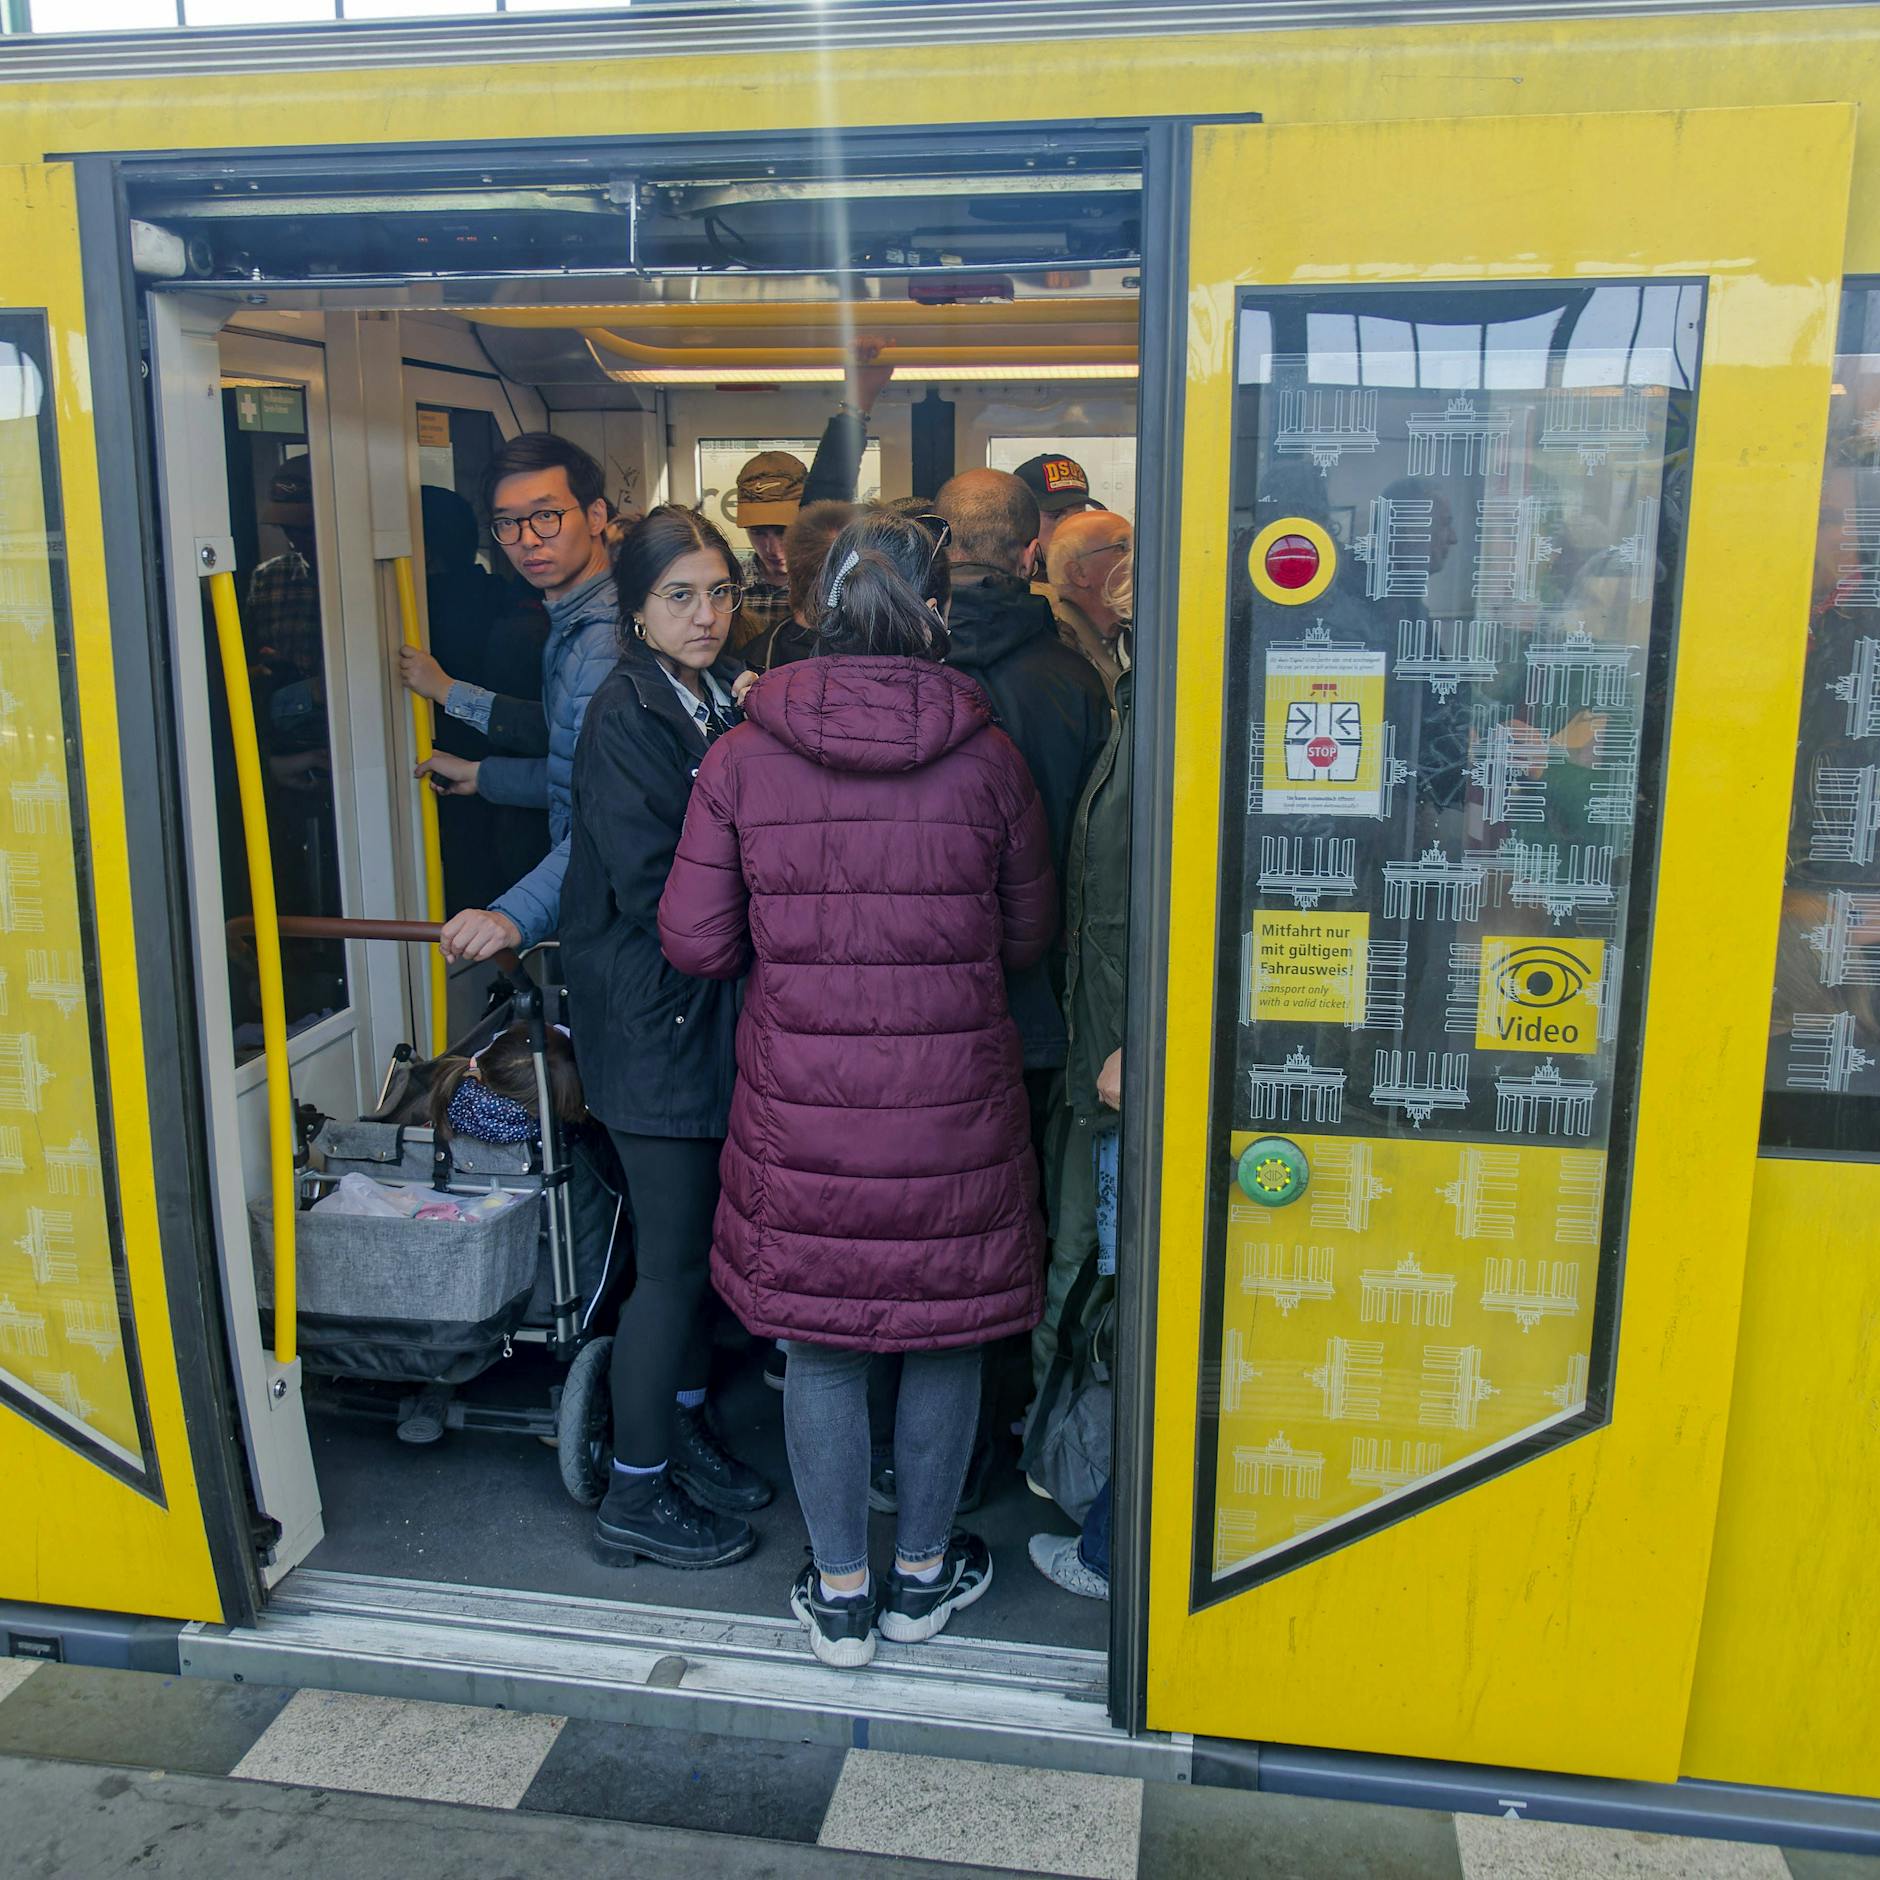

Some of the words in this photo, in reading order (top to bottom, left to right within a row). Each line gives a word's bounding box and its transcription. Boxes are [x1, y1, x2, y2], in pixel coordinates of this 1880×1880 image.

[1308, 746, 1337, 758] STOP
[1262, 924, 1322, 938] Mitfahrt
[1326, 928, 1351, 938] nur
[1261, 943, 1285, 956] mit
[1289, 944, 1353, 960] gültigem
[1260, 962, 1354, 977] Fahrausweis!
[1257, 985, 1306, 995] ransport
[1308, 985, 1330, 996] only
[1259, 997, 1281, 1007] with
[1283, 999, 1290, 1007] a
[1292, 998, 1317, 1008] valid
[1497, 1016, 1579, 1043] Video
